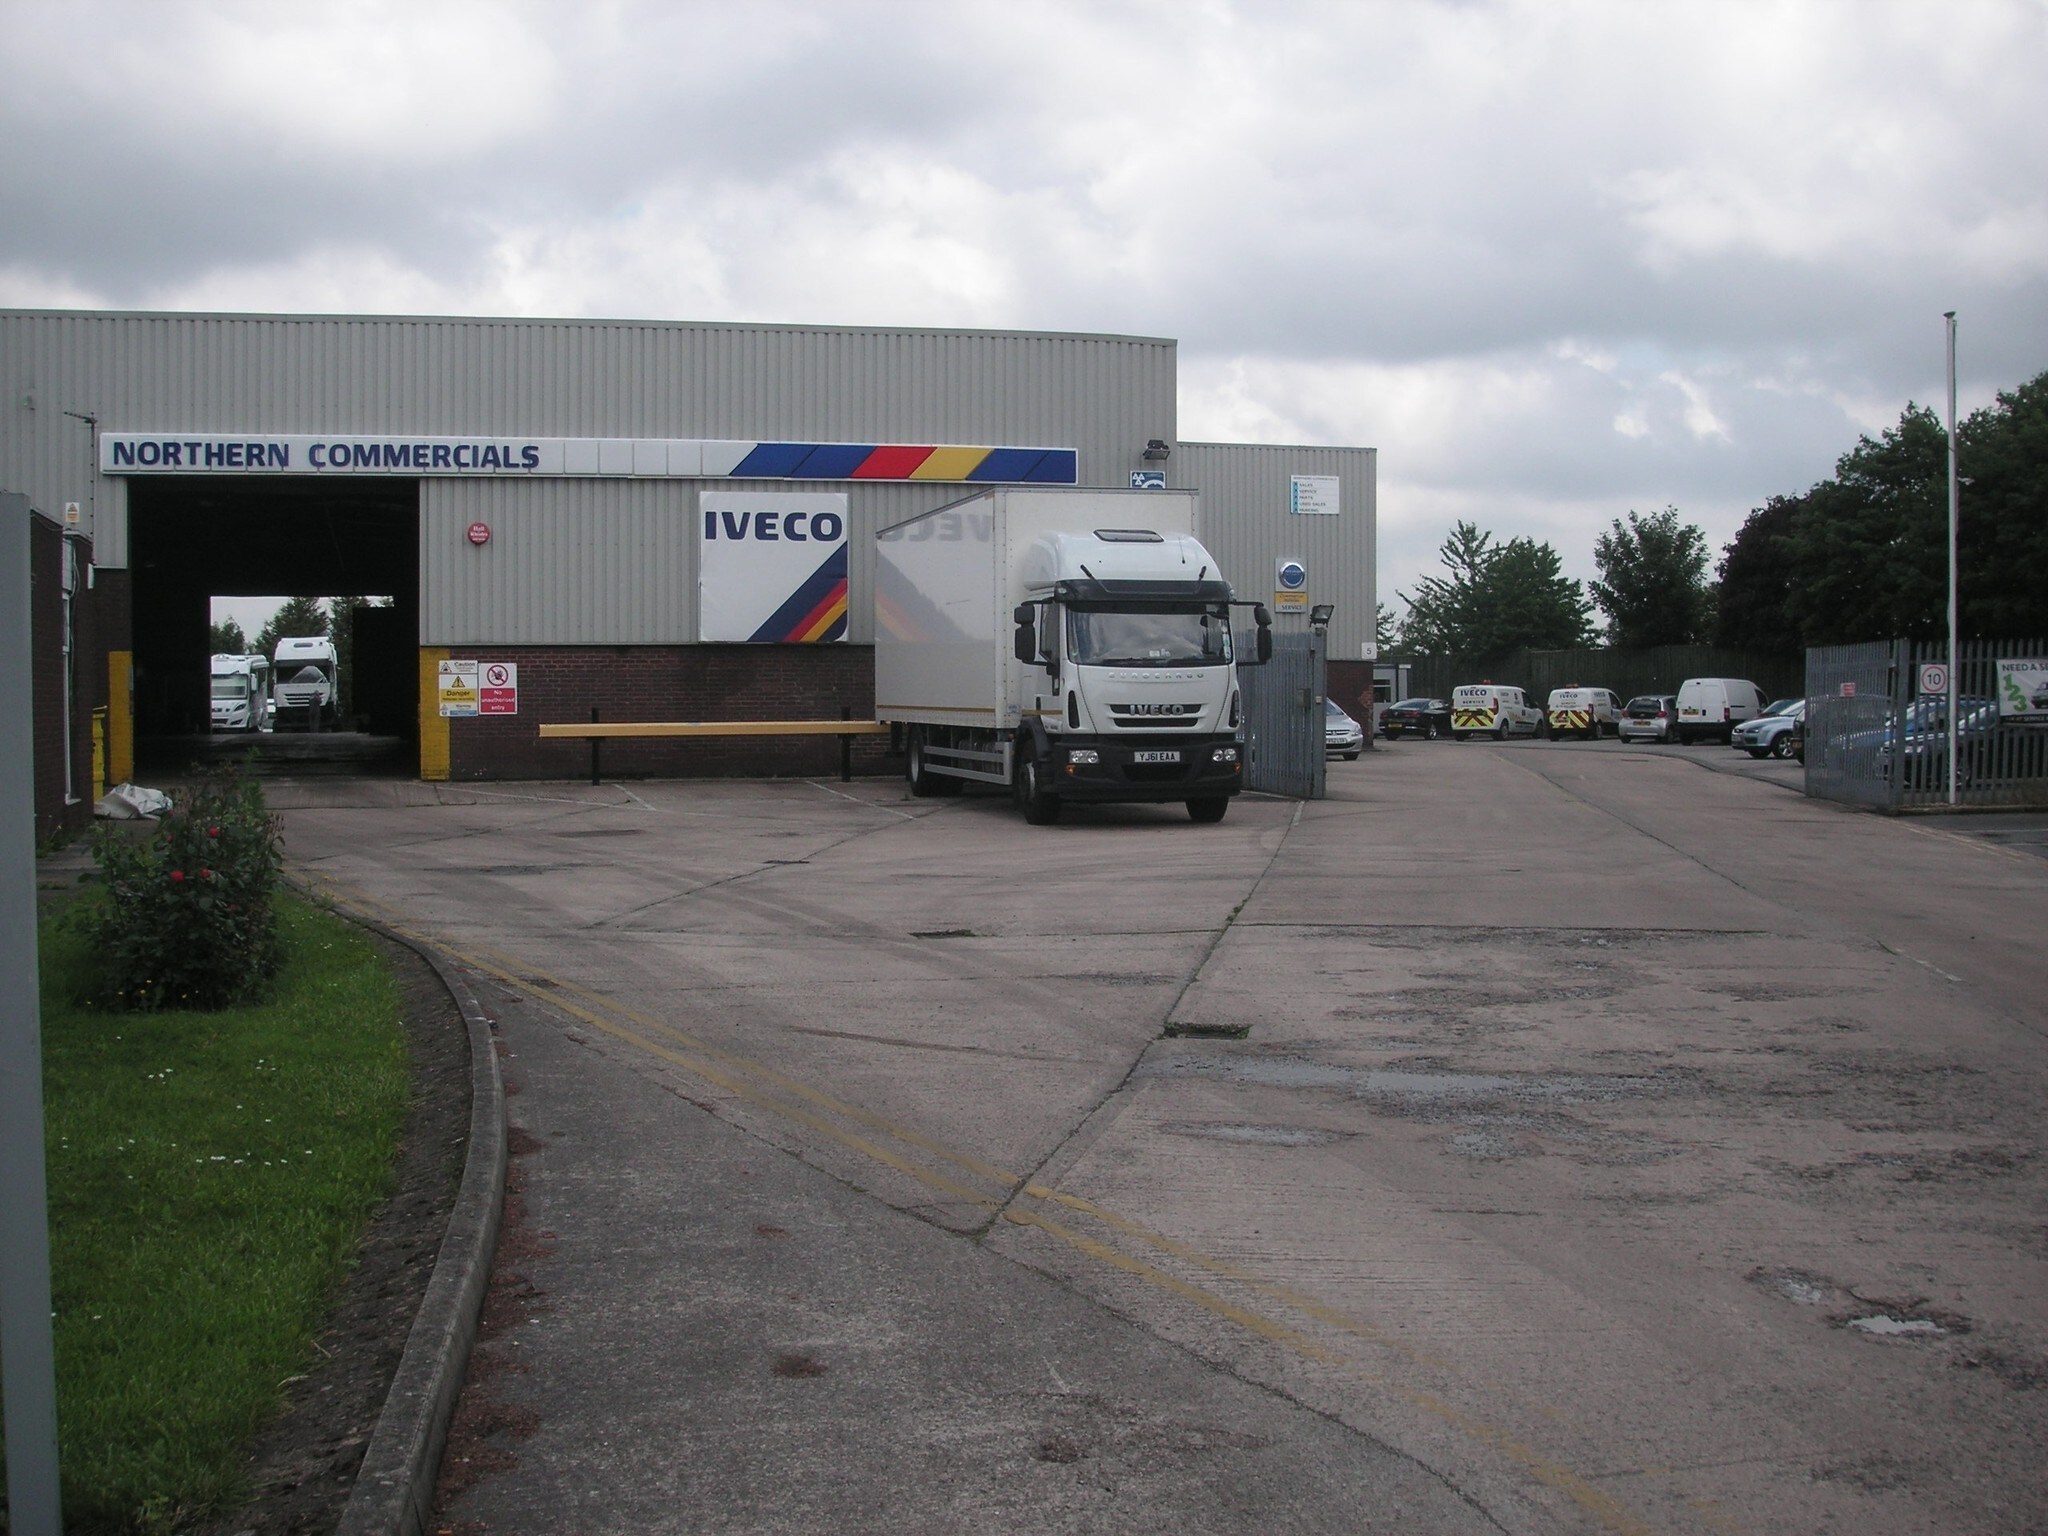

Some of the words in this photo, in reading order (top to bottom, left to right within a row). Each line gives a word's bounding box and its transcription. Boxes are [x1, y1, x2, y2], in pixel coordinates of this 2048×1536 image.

[113, 441, 289, 467] NORTHERN
[308, 443, 540, 468] COMMERCIALS
[705, 511, 842, 542] IVECO
[1367, 647, 1372, 655] 5
[2002, 663, 2028, 671] NEED
[2030, 663, 2037, 671] A
[1927, 673, 1941, 685] 10
[1129, 704, 1184, 716] IVECO
[1140, 753, 1158, 761] YJ61
[1160, 753, 1176, 761] EAA
